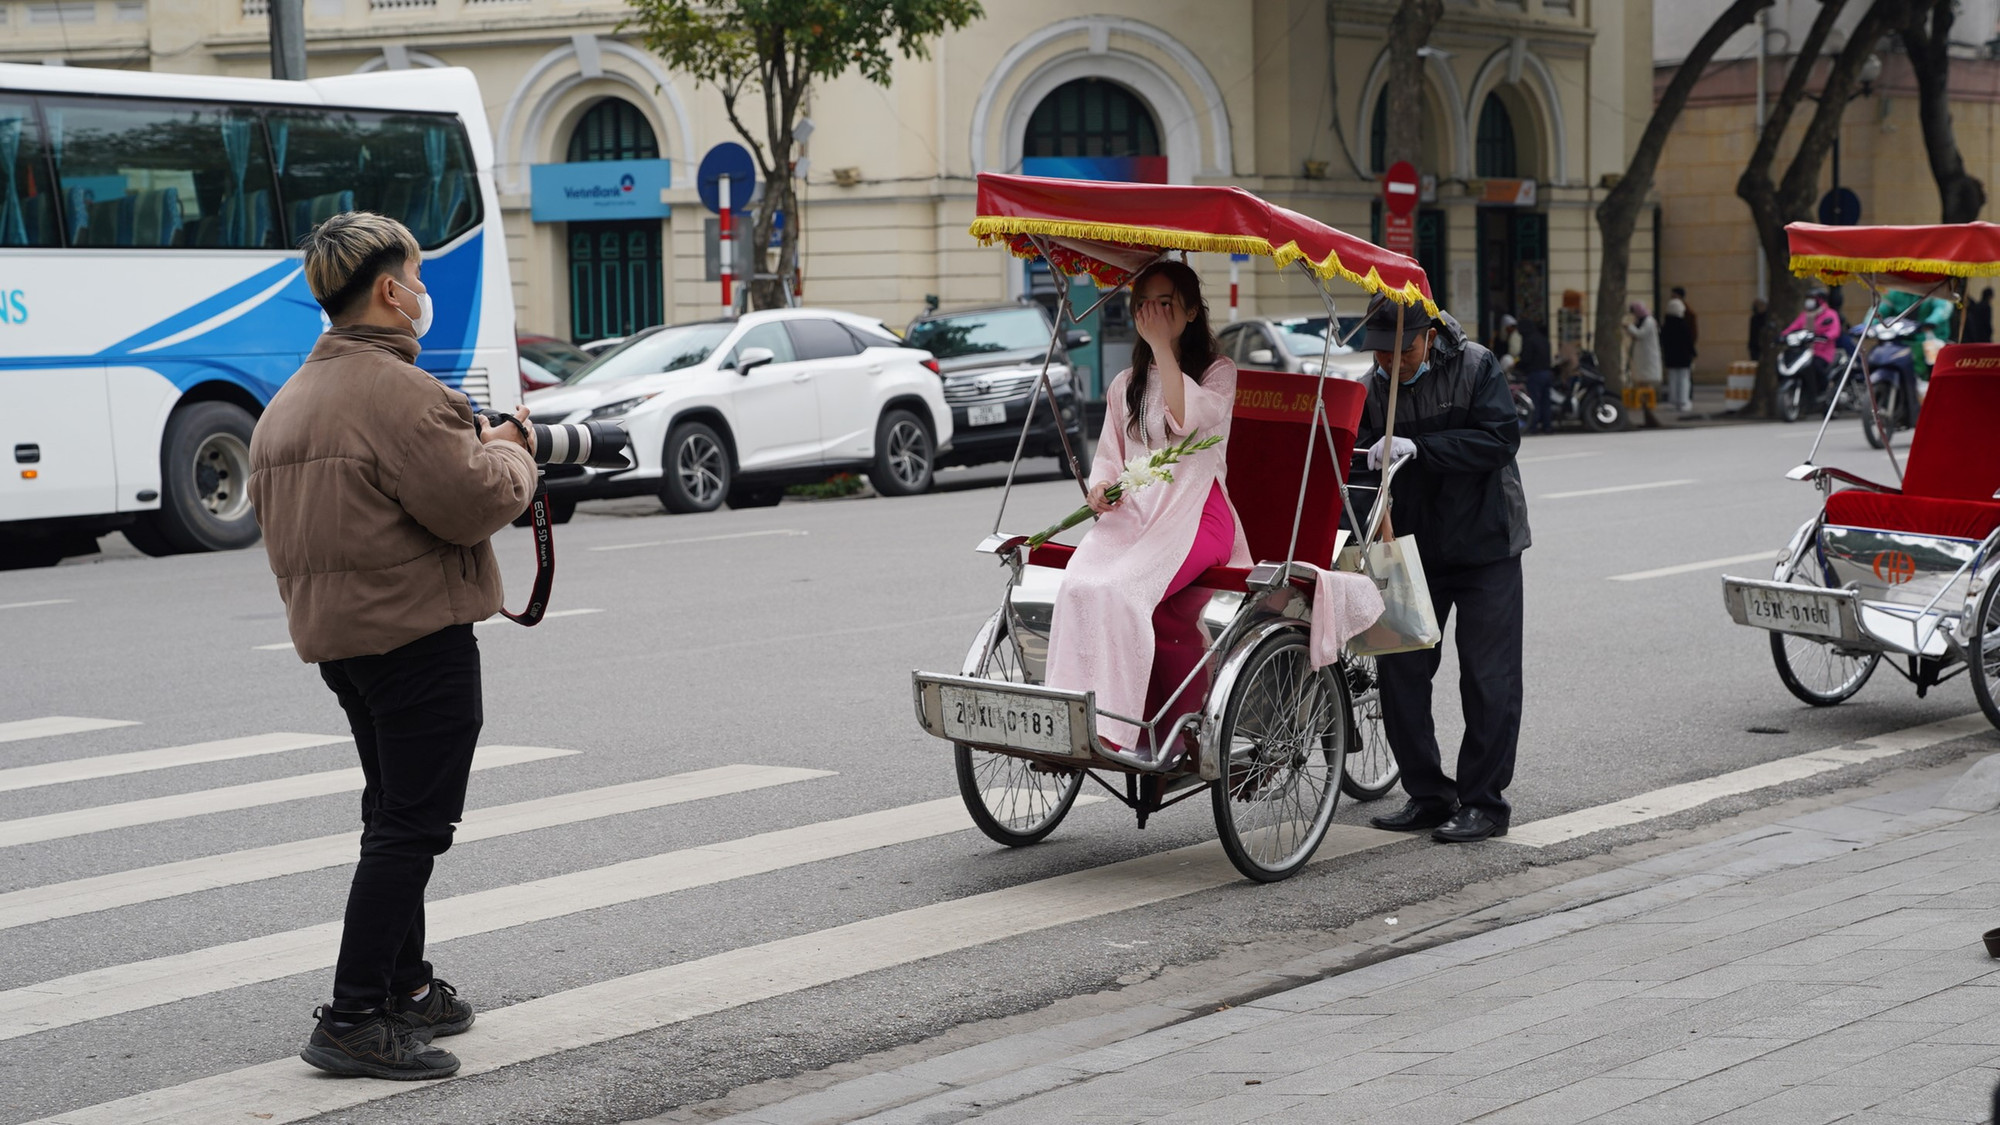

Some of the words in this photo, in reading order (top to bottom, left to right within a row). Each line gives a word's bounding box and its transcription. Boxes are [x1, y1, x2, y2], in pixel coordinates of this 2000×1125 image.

[563, 186, 620, 199] VietinBank
[534, 501, 546, 526] EOS
[538, 529, 548, 542] 5D
[540, 544, 548, 560] Mark
